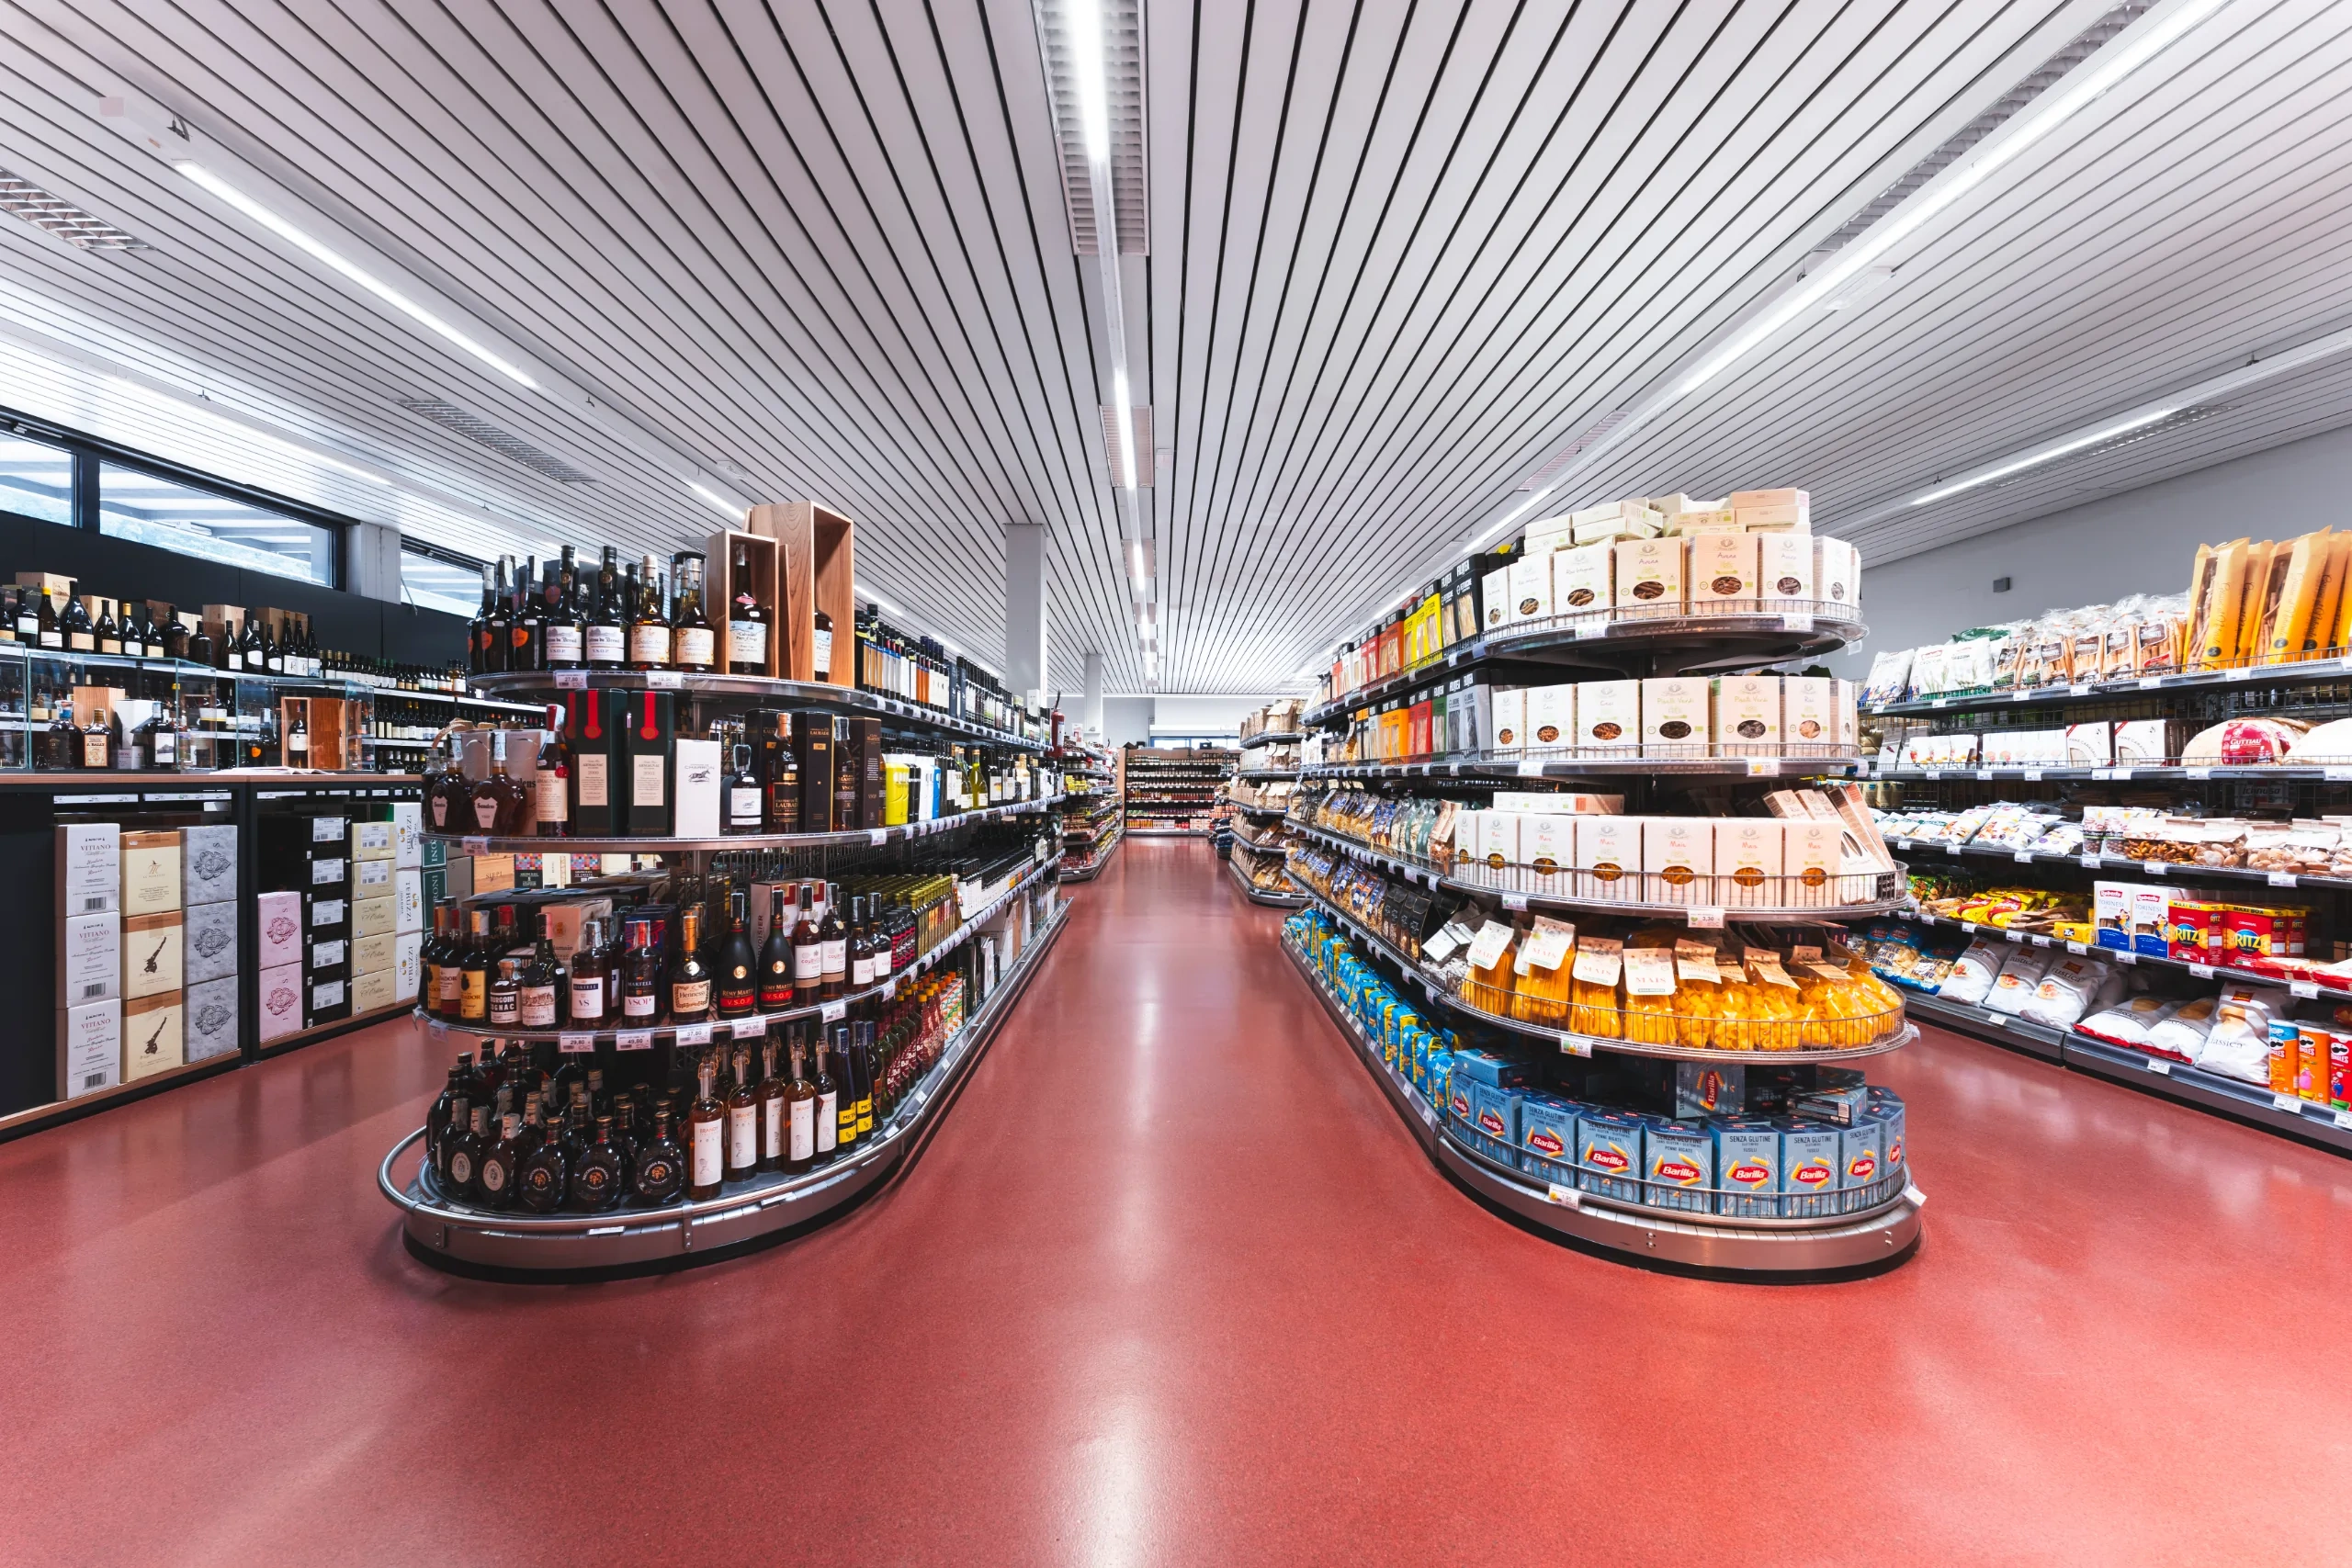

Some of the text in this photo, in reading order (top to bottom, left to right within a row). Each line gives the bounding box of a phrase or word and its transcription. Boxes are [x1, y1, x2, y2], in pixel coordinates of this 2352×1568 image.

[80, 843, 112, 852] VITIANO
[1600, 838, 1615, 846] Mais
[2098, 899, 2124, 908] TORINESI
[2134, 904, 2162, 912] TORINESI
[2273, 920, 2285, 929] RITZ
[2291, 920, 2303, 929] RITZ
[79, 930, 109, 940] VITIANO
[2175, 928, 2200, 942] RITZ
[2234, 934, 2262, 949] RITZ
[1475, 947, 1494, 960] MAIS
[1532, 947, 1556, 959] MAIS
[1965, 948, 1984, 957] ustica
[1583, 965, 1612, 976] MAIS
[2052, 966, 2081, 982] rustica
[81, 1018, 111, 1030] VITIANO
[1708, 1074, 1716, 1103] Barilla
[1479, 1087, 1506, 1103] SENZA GLUTINE
[1454, 1100, 1467, 1112] Barilla
[1529, 1105, 1566, 1121] SENZA GLUTINE
[1482, 1118, 1502, 1131] Barilla
[1588, 1122, 1631, 1134] SENZA GLUTINE
[1677, 1135, 1702, 1144] GLUTINE
[1849, 1128, 1876, 1139] SENZA GLUTINE
[1533, 1135, 1560, 1150] Barilla
[1592, 1154, 1624, 1166] Barilla
[1662, 1166, 1695, 1178] Barilla
[1853, 1162, 1873, 1174] Barilla
[1736, 1170, 1765, 1179] Barilla
[1800, 1170, 1826, 1179] Barilla
